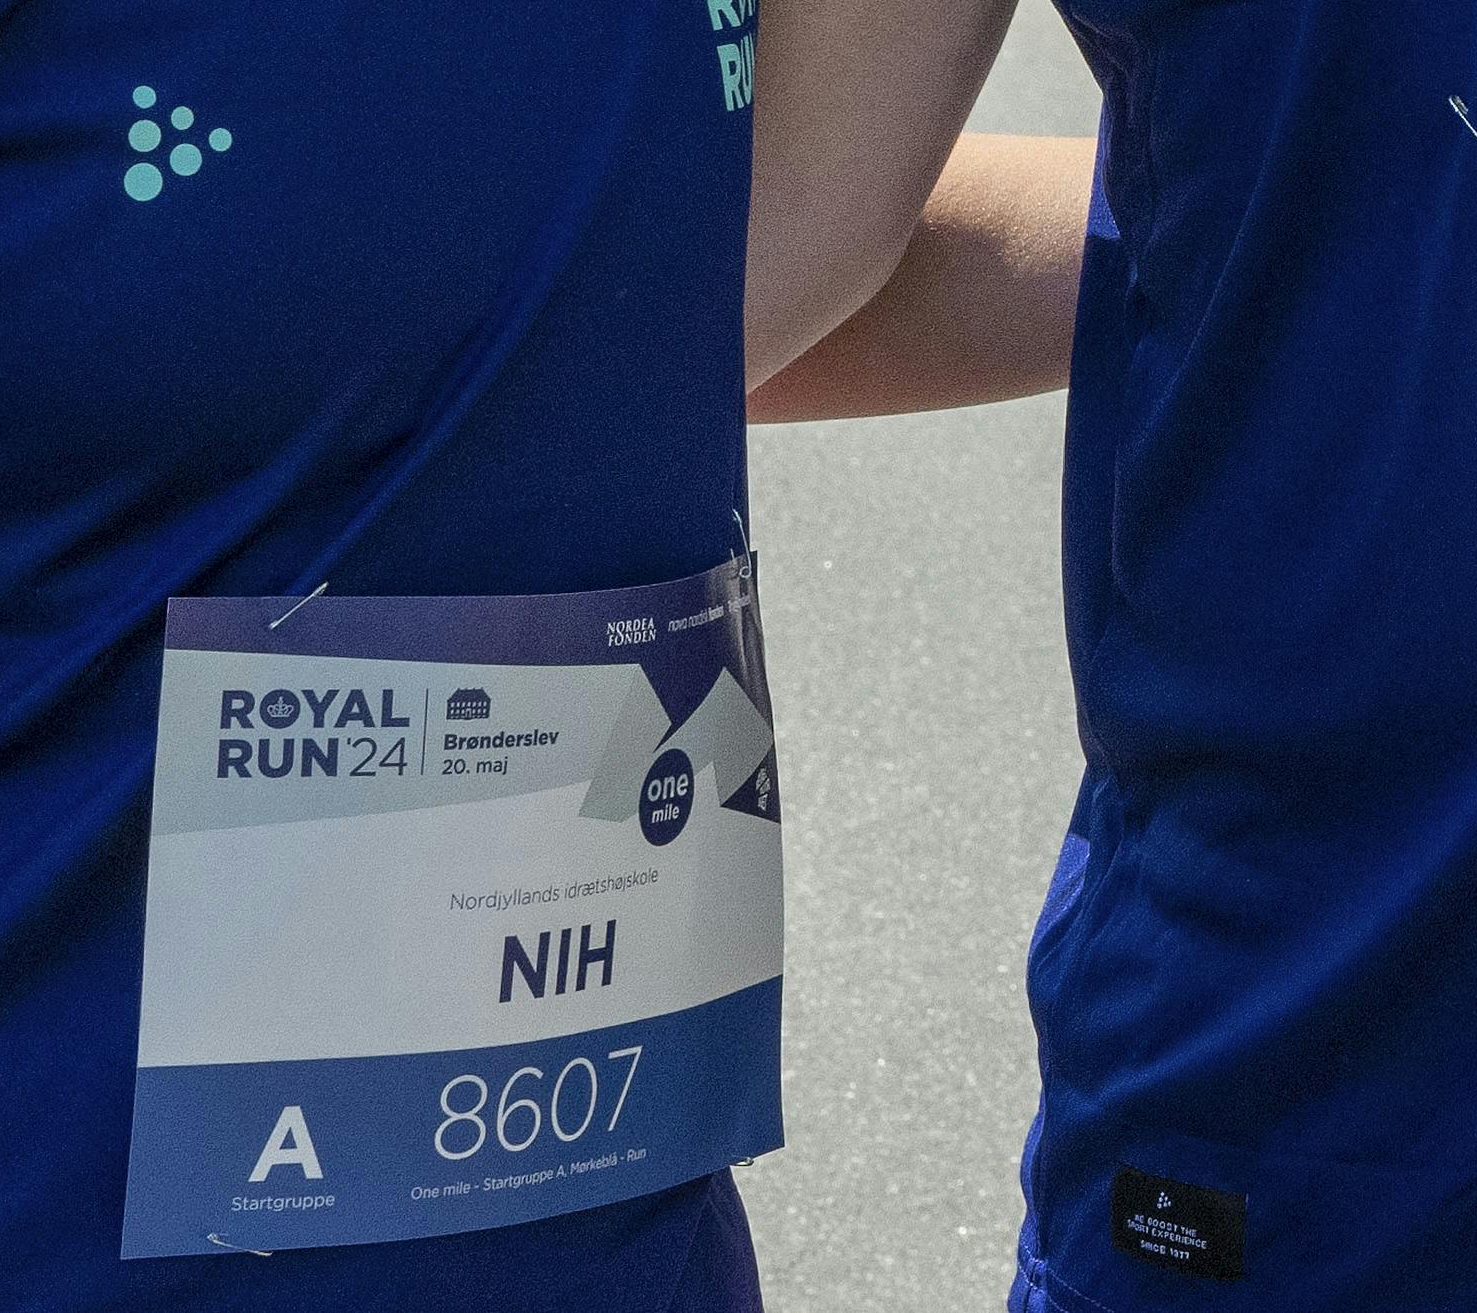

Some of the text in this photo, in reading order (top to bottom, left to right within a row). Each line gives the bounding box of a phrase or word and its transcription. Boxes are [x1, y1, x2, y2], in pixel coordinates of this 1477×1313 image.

[607, 617, 654, 634] NORDEA
[608, 629, 656, 647] FONDEN
[220, 689, 410, 729] ROYAL
[444, 728, 559, 751] Brønderslev
[443, 756, 508, 776] 20. maj
[647, 774, 689, 802] one
[651, 805, 680, 824] mile
[450, 886, 560, 911] Nordjyllands
[499, 919, 617, 1003] NIH
[434, 1046, 643, 1160] 8607
[248, 1105, 323, 1182] A
[411, 1186, 439, 1200] One
[443, 1181, 472, 1196] mile
[483, 1168, 554, 1191] Startgruppe
[627, 1147, 646, 1162] Run
[231, 1192, 335, 1212] Startgruppe
